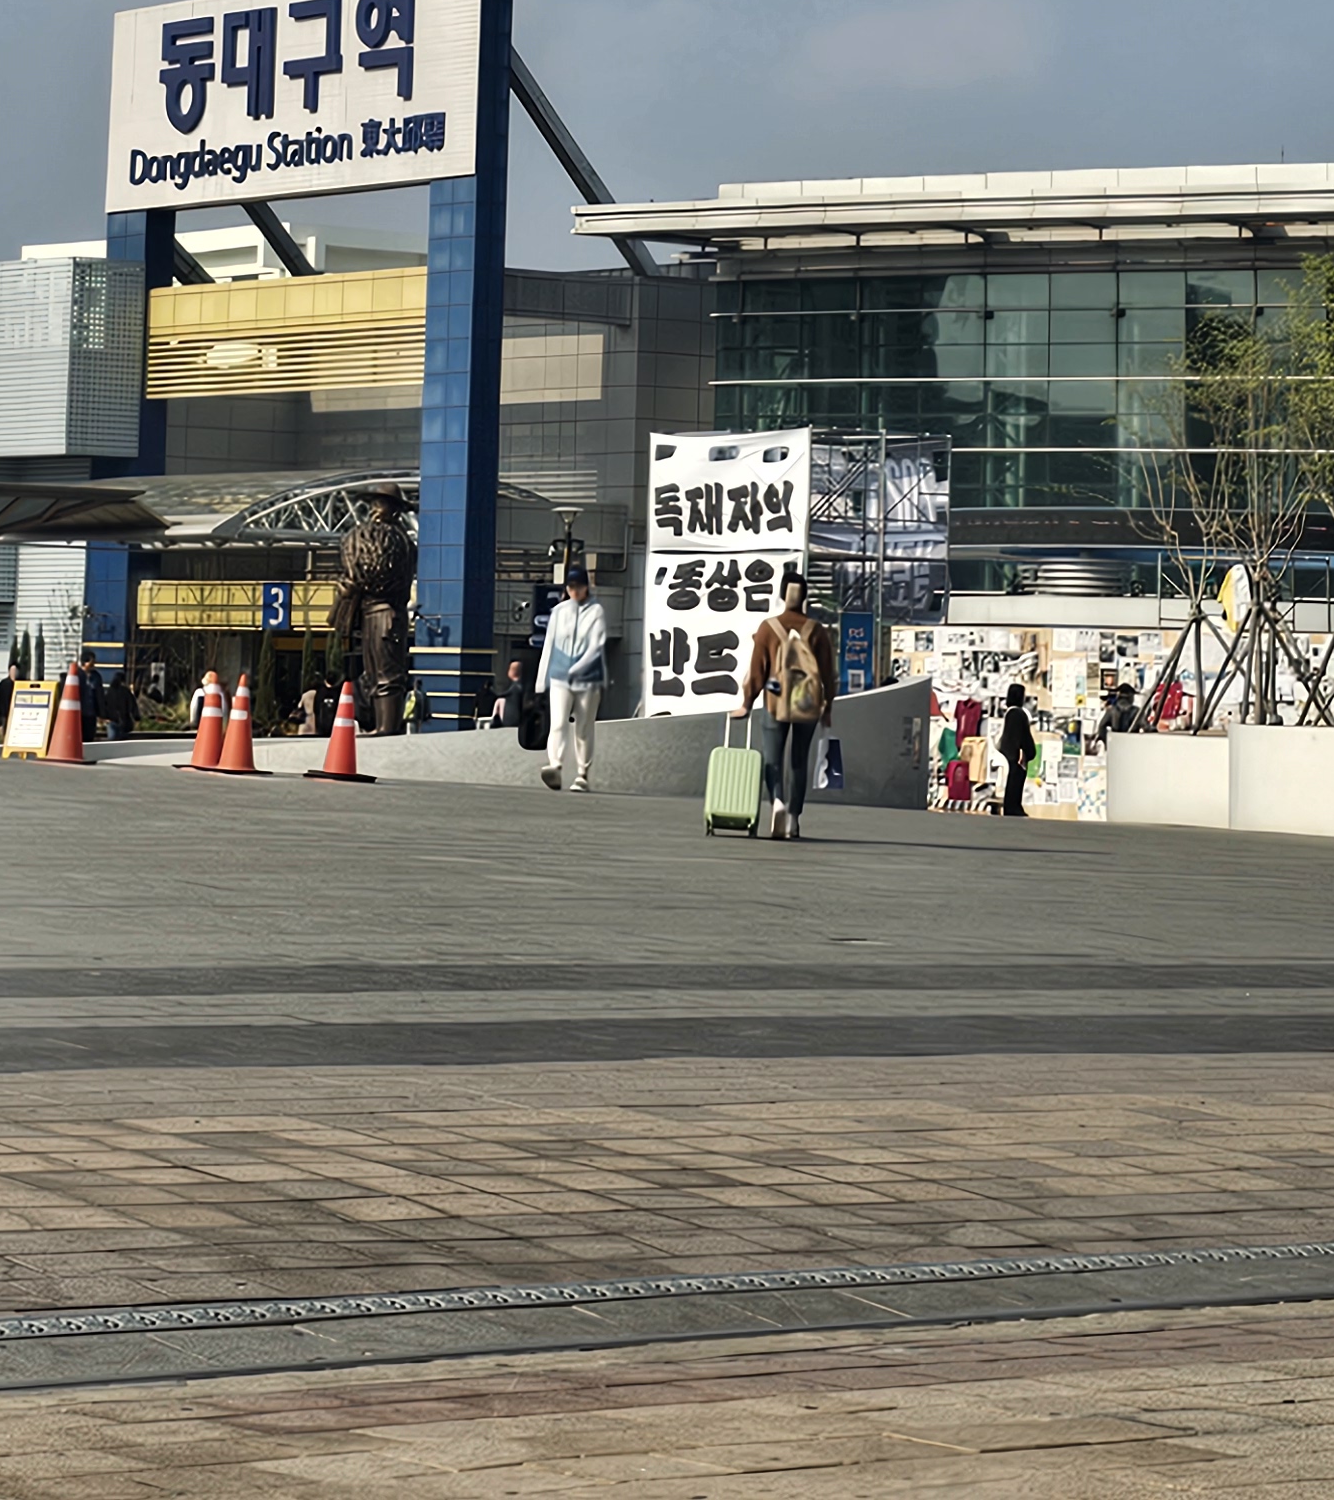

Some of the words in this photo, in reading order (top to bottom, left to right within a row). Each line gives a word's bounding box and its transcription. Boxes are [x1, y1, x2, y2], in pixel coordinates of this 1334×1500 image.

[129, 138, 262, 190] Dongdaegu
[267, 126, 353, 171] Station
[654, 479, 795, 537] 독재자의
[268, 586, 285, 627] 3
[649, 626, 740, 698] 반드
